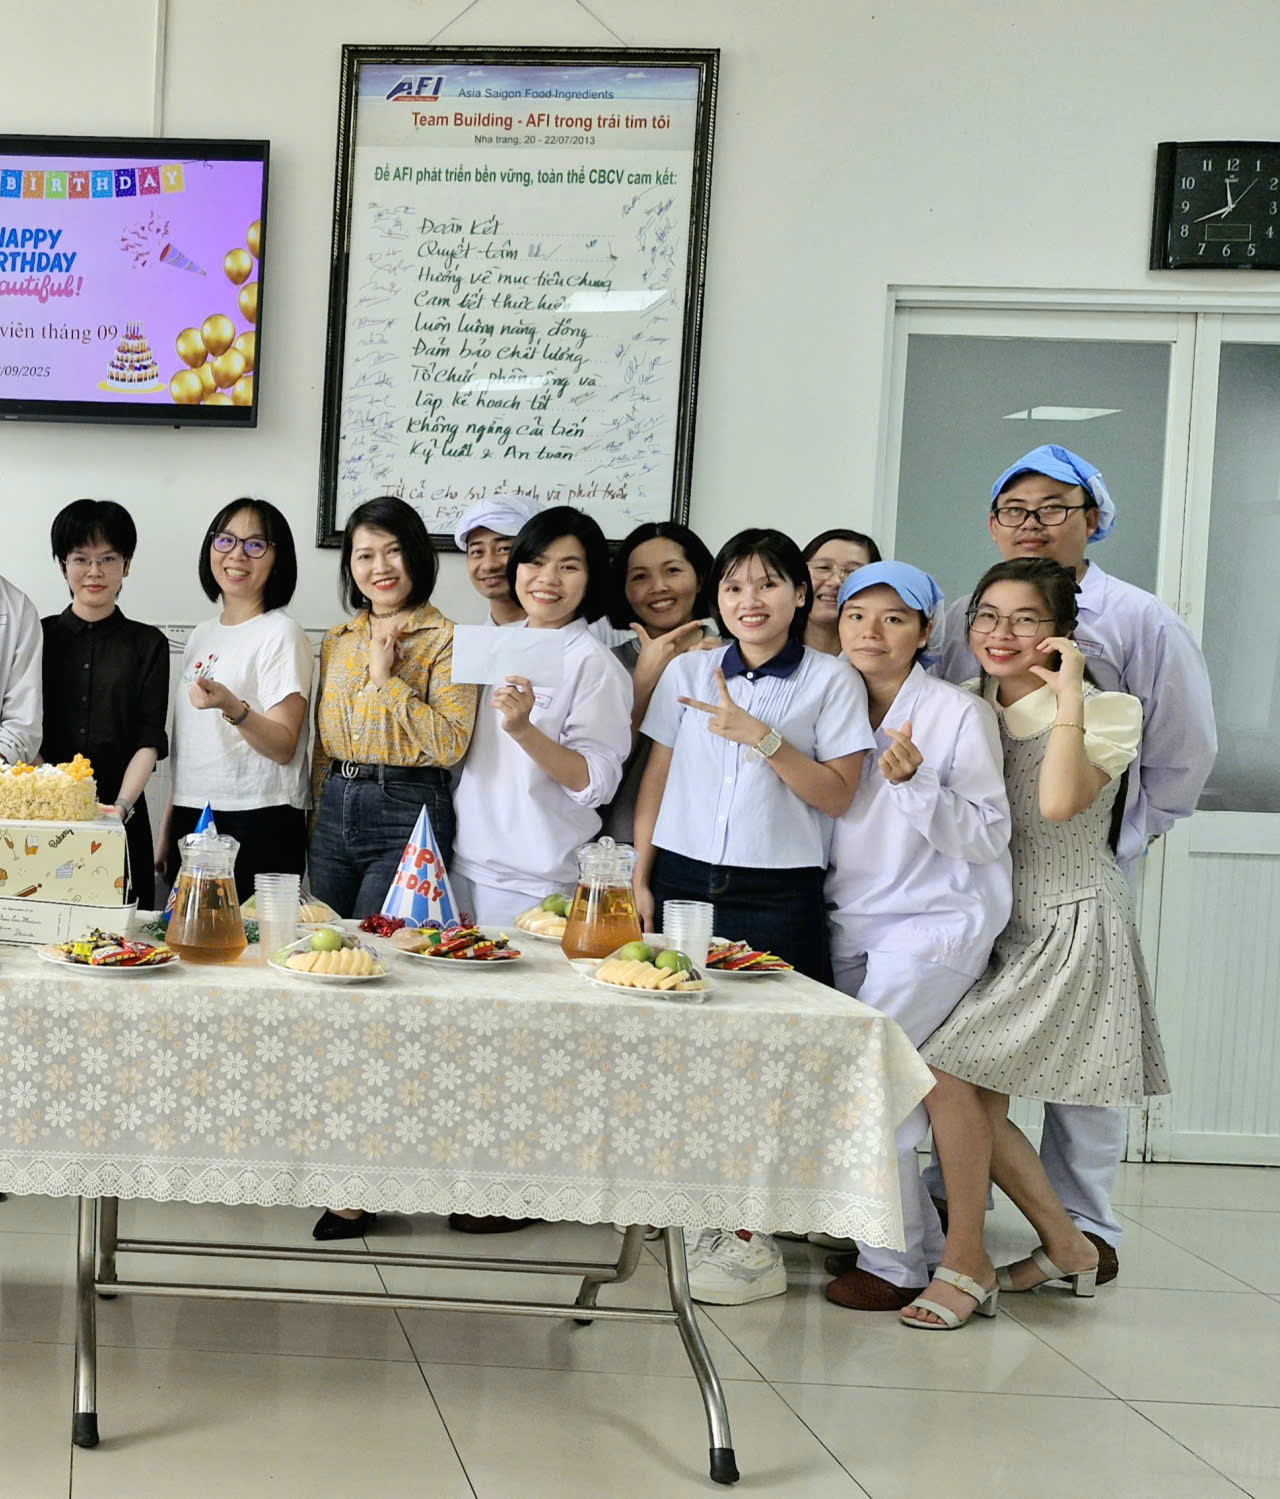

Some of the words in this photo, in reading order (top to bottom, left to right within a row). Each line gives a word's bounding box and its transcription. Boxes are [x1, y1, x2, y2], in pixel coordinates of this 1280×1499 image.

[386, 76, 443, 100] AFI
[458, 88, 481, 98] Asia
[484, 88, 522, 101] Saigon
[524, 88, 552, 99] Food
[554, 89, 615, 101] Ingredients
[411, 111, 449, 126] Team
[453, 112, 513, 130] Building
[525, 112, 550, 127] AFI
[554, 114, 593, 131] trong
[597, 114, 621, 129] trái
[625, 114, 648, 129] tim
[652, 114, 671, 129] tôi
[474, 135, 493, 144] Nha
[495, 135, 520, 146] trang,
[523, 135, 536, 144] 20
[544, 135, 596, 145] 22/07/2013
[1202, 159, 1213, 172] 11
[1226, 158, 1240, 171] 12
[1256, 159, 1261, 172] 1
[375, 162, 390, 182] Để
[392, 165, 413, 182] AFI
[416, 166, 442, 185] phát
[445, 163, 472, 183] triển
[500, 167, 534, 187] vững,
[537, 167, 564, 184] toàn
[567, 164, 585, 184] thể
[589, 168, 625, 185] CBCV
[627, 172, 652, 185] cam
[6, 170, 179, 193] BIRTHDAY
[1181, 177, 1196, 190] 10
[1270, 178, 1279, 191] 2
[1181, 201, 1190, 213] 9
[1269, 202, 1278, 215] 3
[1180, 224, 1189, 238] 8
[1266, 226, 1274, 239] 4
[1198, 243, 1207, 255] 7
[1222, 244, 1231, 257] 6
[1247, 243, 1256, 257] 5
[0, 321, 35, 339] viên
[41, 322, 92, 345] tháng
[97, 324, 118, 341] 09
